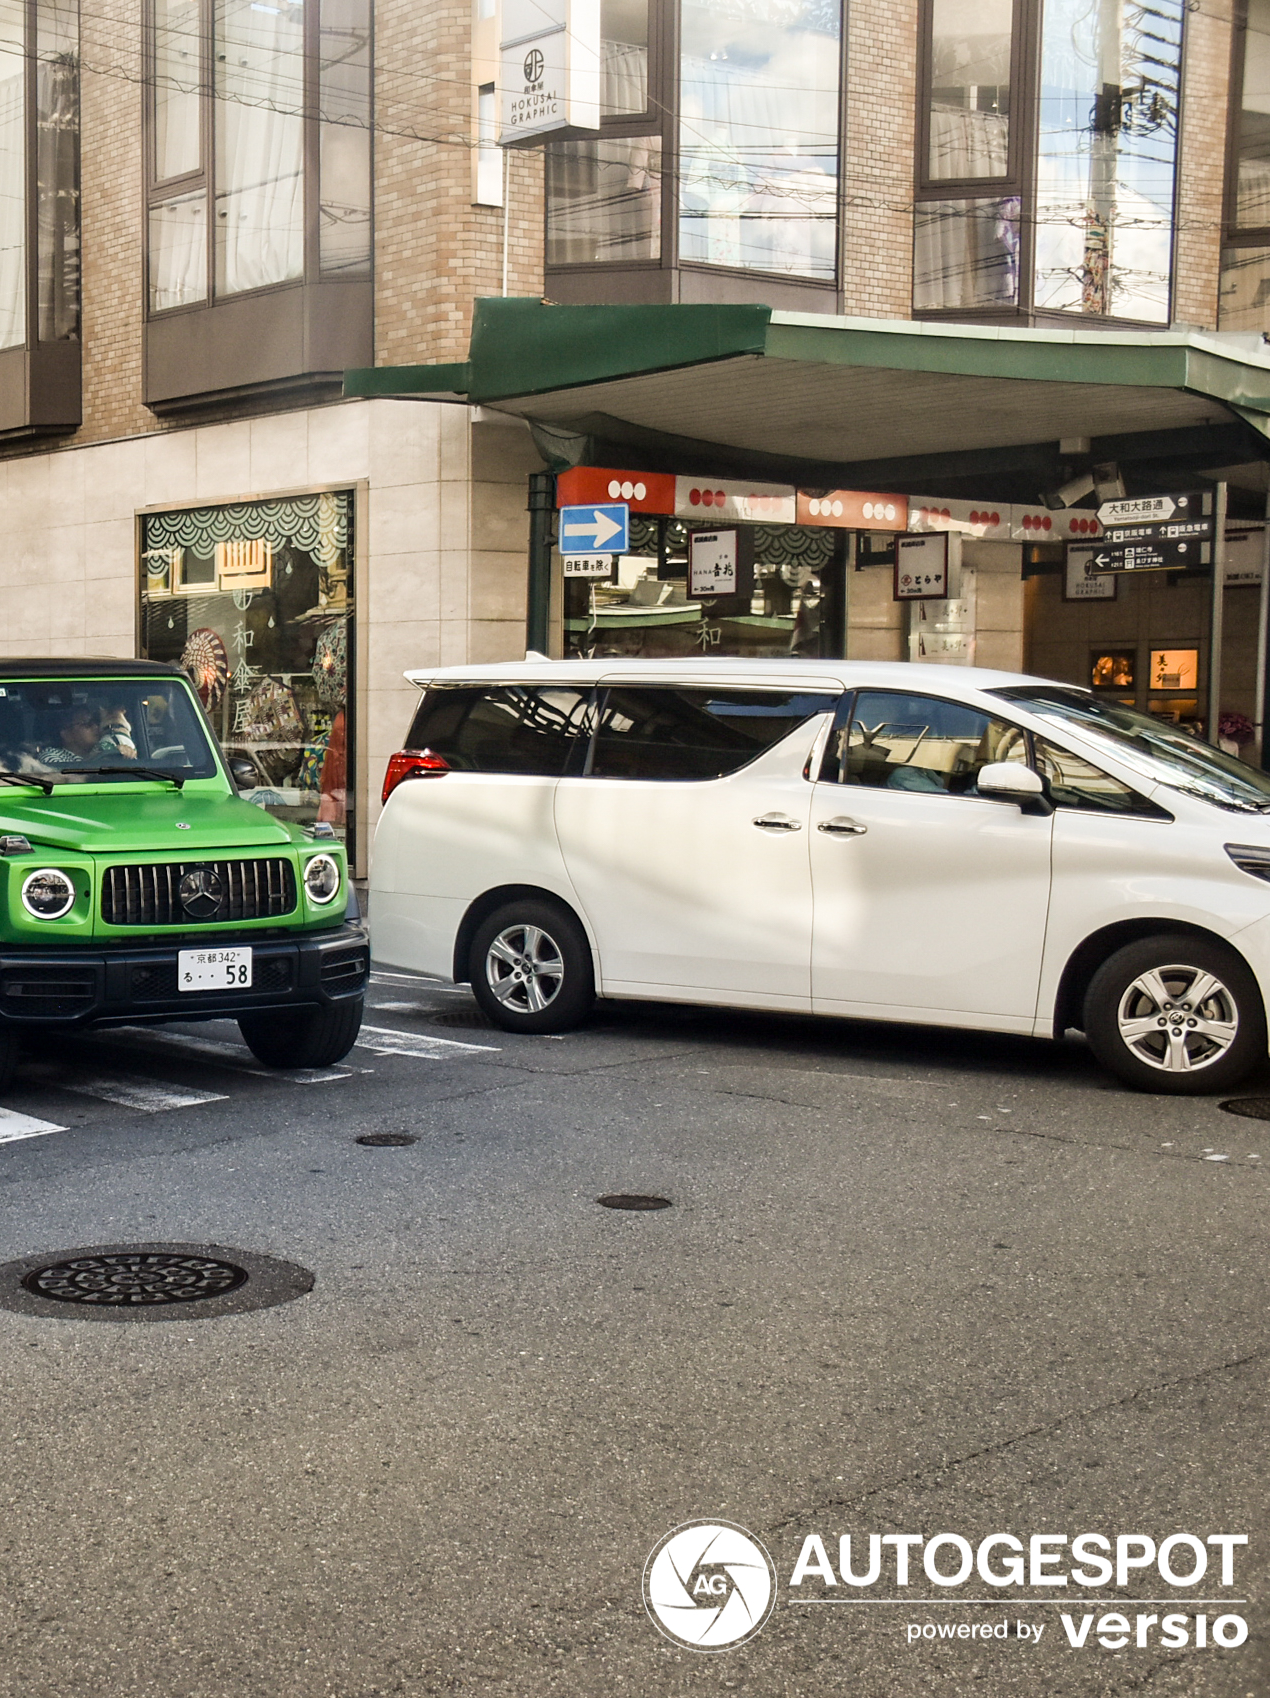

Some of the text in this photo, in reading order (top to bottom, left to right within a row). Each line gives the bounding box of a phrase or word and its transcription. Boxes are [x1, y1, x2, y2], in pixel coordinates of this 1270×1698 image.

[511, 90, 556, 112] HOKUSAI
[511, 103, 557, 125] GRAPHIC
[1109, 500, 1163, 514] 大和大路通
[566, 560, 609, 572] 自転車を除く
[915, 574, 942, 585] とらや
[695, 617, 722, 652] 和
[232, 619, 254, 735] 和傘屋
[183, 972, 193, 983] る
